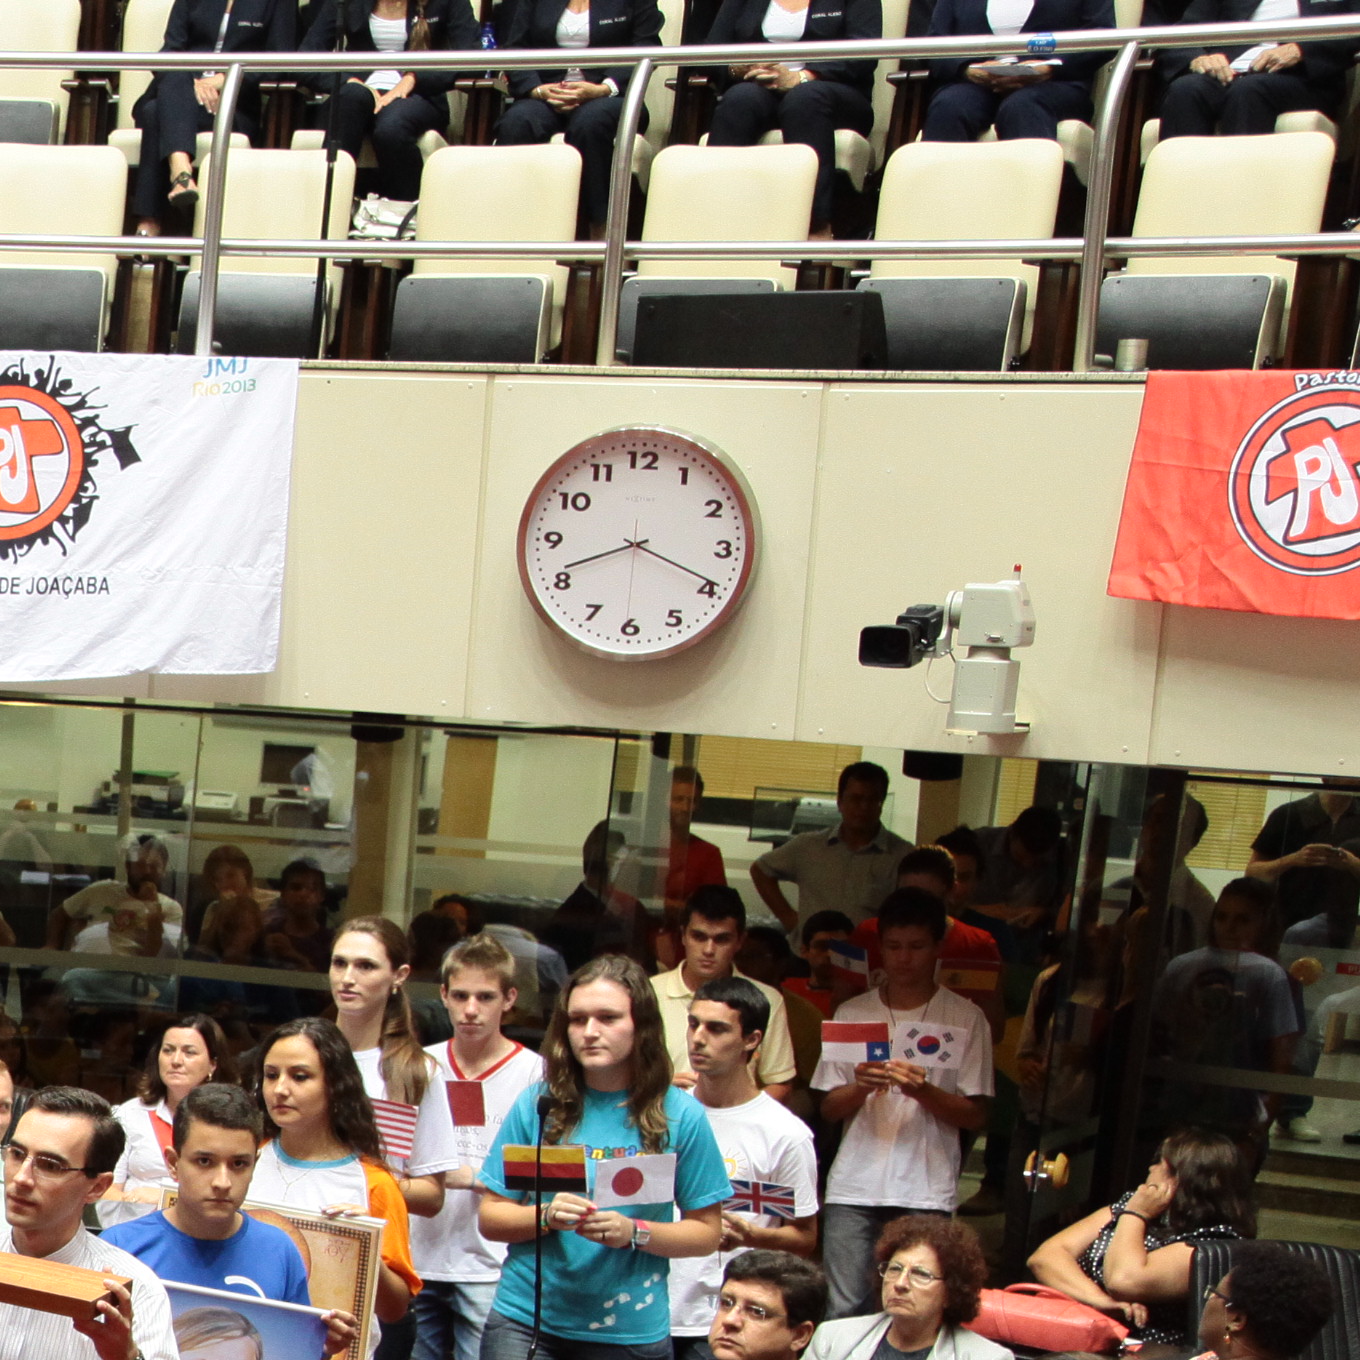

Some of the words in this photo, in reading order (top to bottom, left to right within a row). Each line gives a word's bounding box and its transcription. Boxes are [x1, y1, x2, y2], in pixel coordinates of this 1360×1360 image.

[202, 356, 248, 378] JMJ
[627, 451, 659, 470] 12
[590, 463, 613, 482] 11
[678, 467, 689, 485] 1
[558, 492, 591, 511] 10
[704, 499, 723, 518] 2
[543, 531, 563, 549] 9
[713, 540, 732, 559] 3
[26, 576, 111, 599] JOAÇABA
[553, 572, 571, 590] 8
[584, 604, 604, 621] 7
[665, 610, 683, 627] 5
[620, 618, 640, 636] 6
